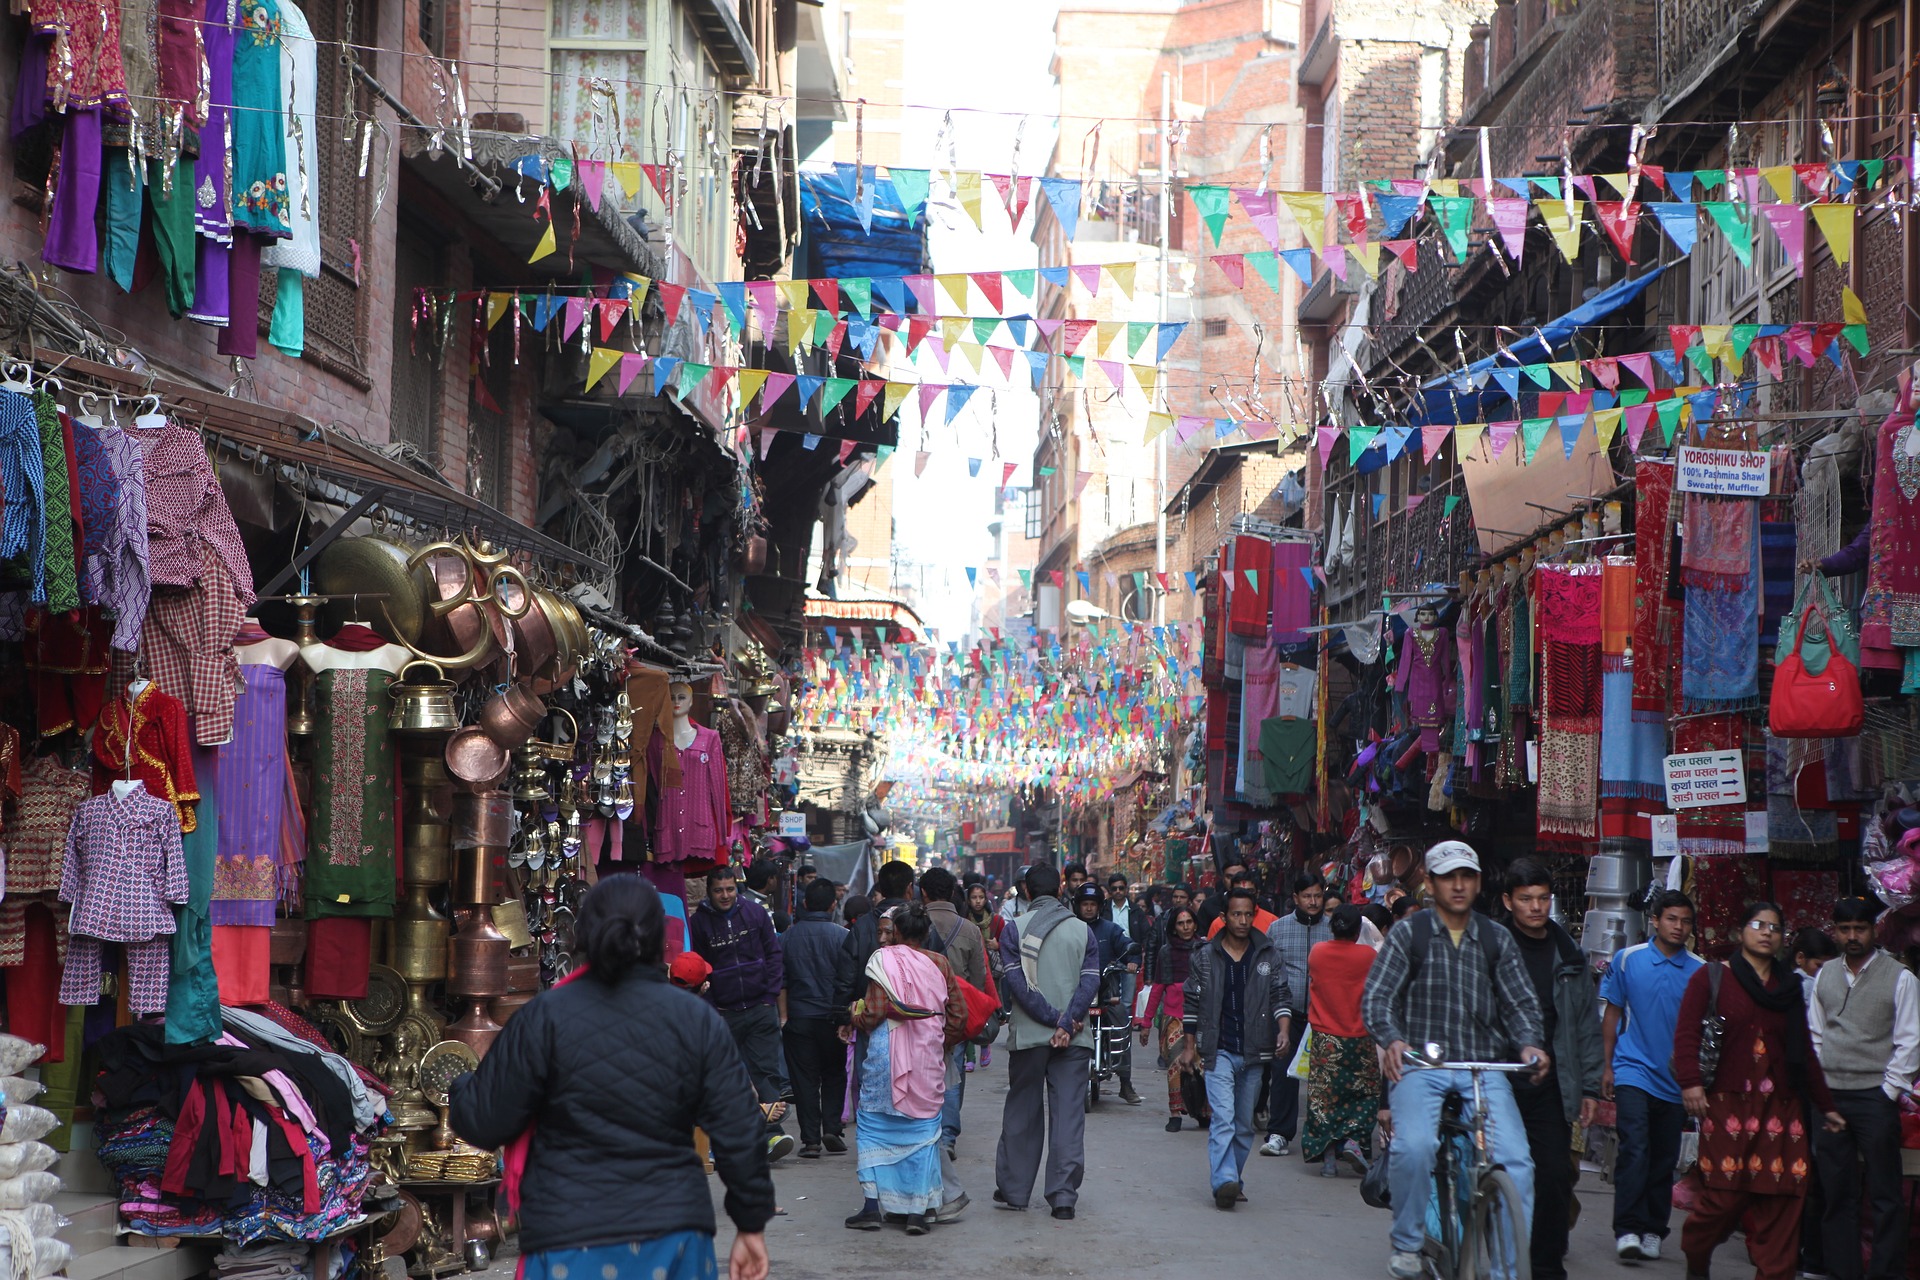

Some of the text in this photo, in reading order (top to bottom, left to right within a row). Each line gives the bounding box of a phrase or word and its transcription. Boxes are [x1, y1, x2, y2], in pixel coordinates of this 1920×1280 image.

[1684, 450, 1766, 469] YOROSHIKU SHOP
[1682, 467, 1765, 481] 100% Pashmina Shawl
[1687, 480, 1759, 492] Sweater, Muffler
[1689, 757, 1712, 765] पसल
[1695, 768, 1718, 777] पसल
[1694, 780, 1718, 789] पसल
[1697, 791, 1719, 800] पसल
